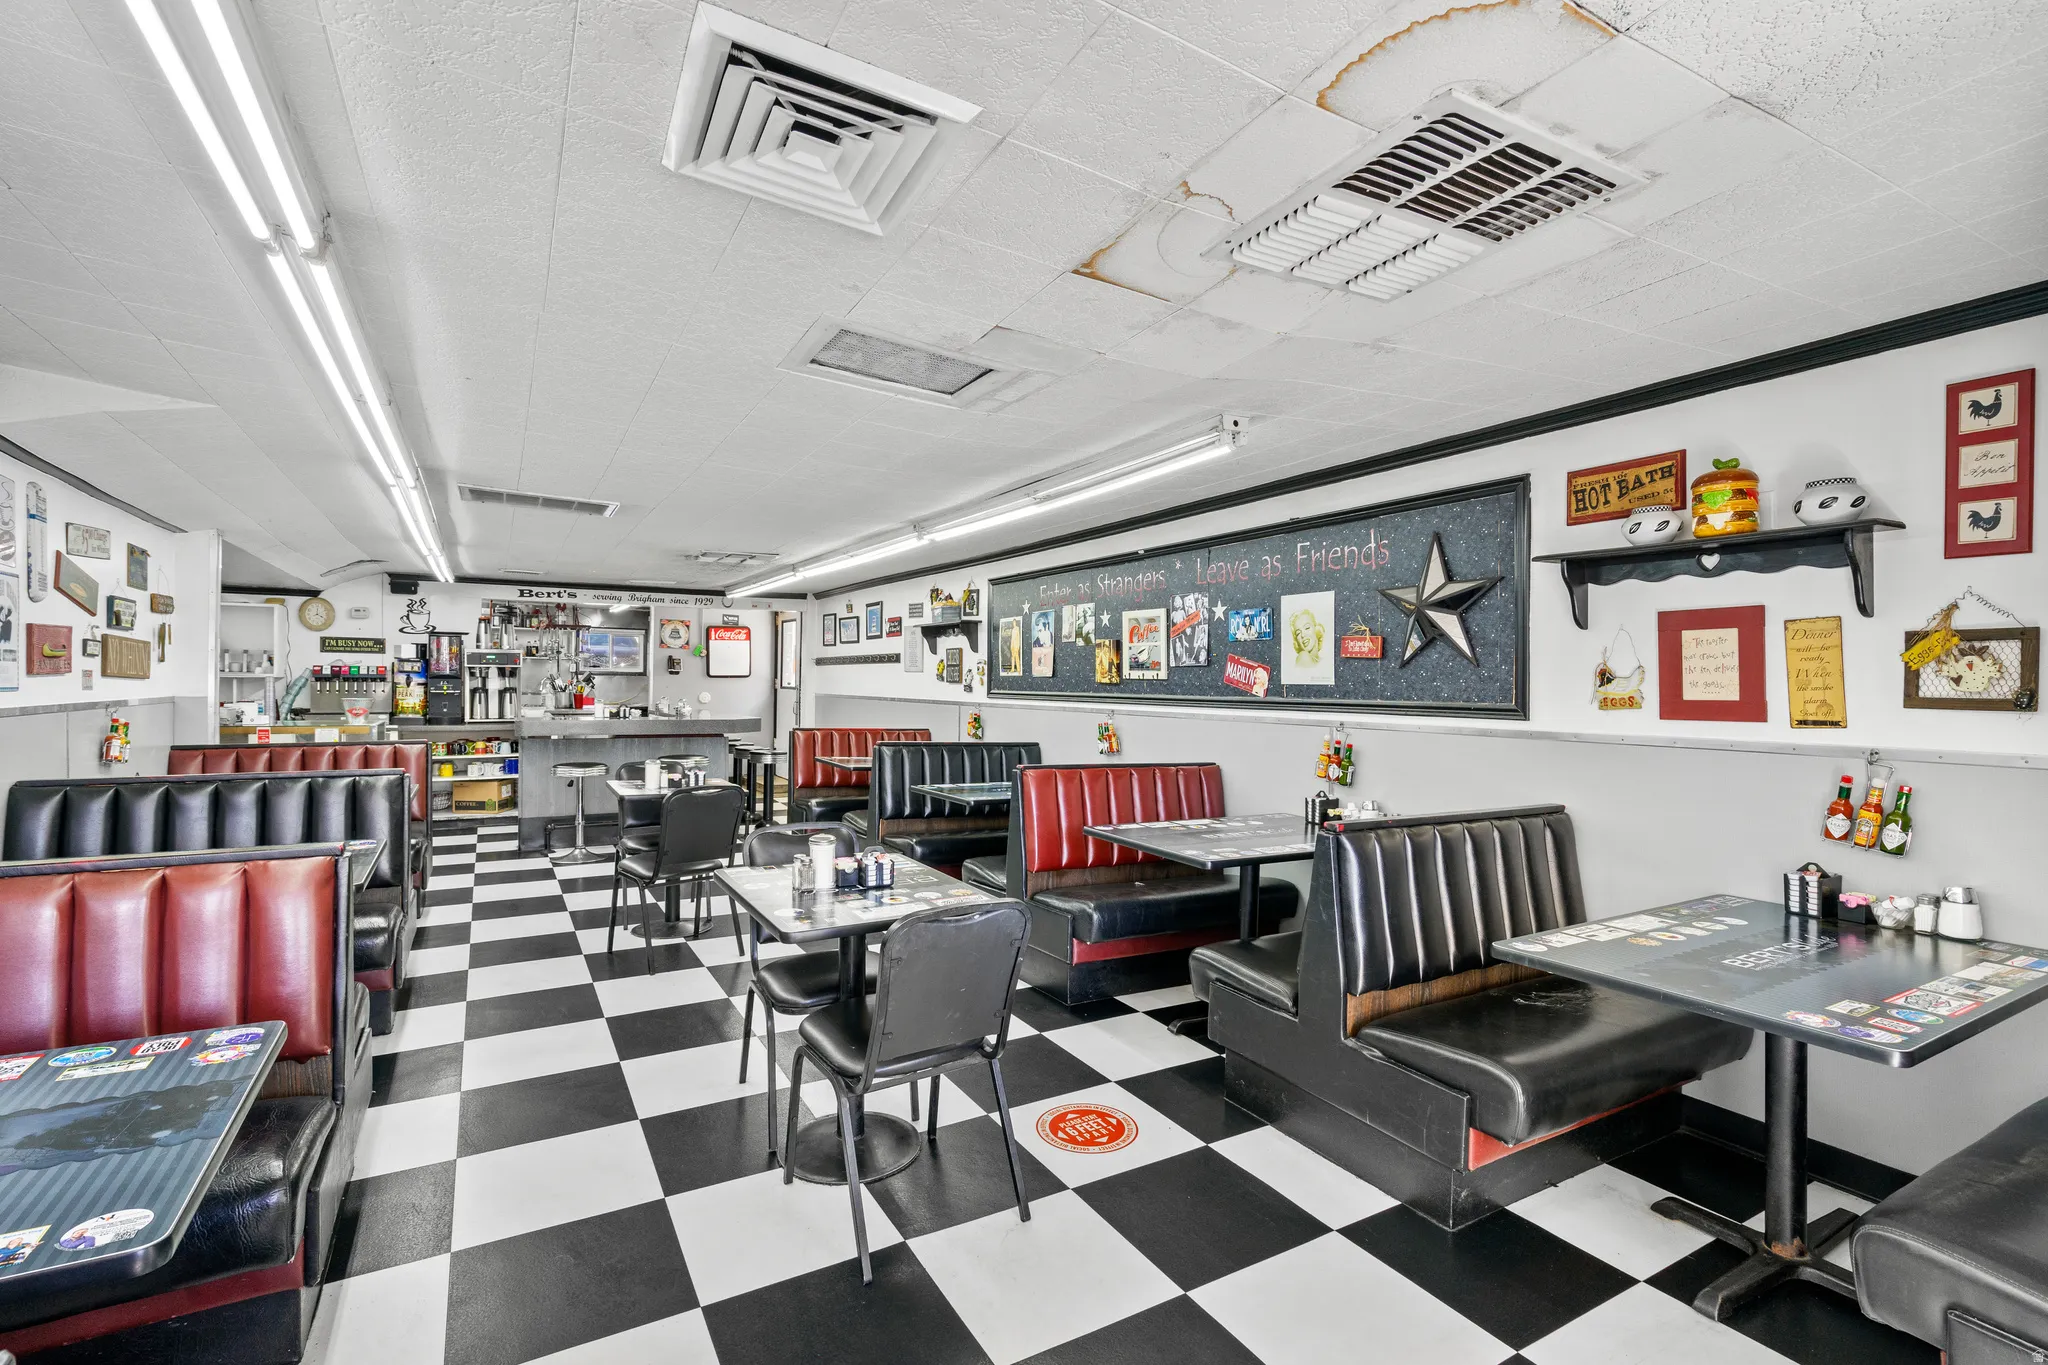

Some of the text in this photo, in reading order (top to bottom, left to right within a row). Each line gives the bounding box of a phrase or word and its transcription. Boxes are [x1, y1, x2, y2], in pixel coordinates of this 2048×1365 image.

[1573, 477, 1609, 489] FRESH
[1573, 462, 1675, 513] HOT BATH
[1629, 492, 1660, 504] USED
[1040, 528, 1389, 607] Enter as Strangers Leave as Friends
[517, 588, 714, 606] Bert's serving Brigham since 1929
[715, 628, 748, 640] Coca-Cola
[1129, 624, 1160, 643] Coffee
[1791, 628, 1837, 641] Dinner
[325, 639, 337, 647] I'M
[1796, 643, 1831, 653] will be
[1721, 650, 1735, 659] but
[1799, 654, 1825, 664] ready
[1226, 662, 1255, 686] MARILYN
[1796, 661, 1832, 679] When
[1796, 683, 1834, 692] the smoke
[1603, 696, 1635, 707] EGGS
[1058, 1113, 1098, 1129] PLEASE STAY
[1065, 1118, 1107, 1136] 6 FEET
[1075, 1126, 1115, 1142] APART
